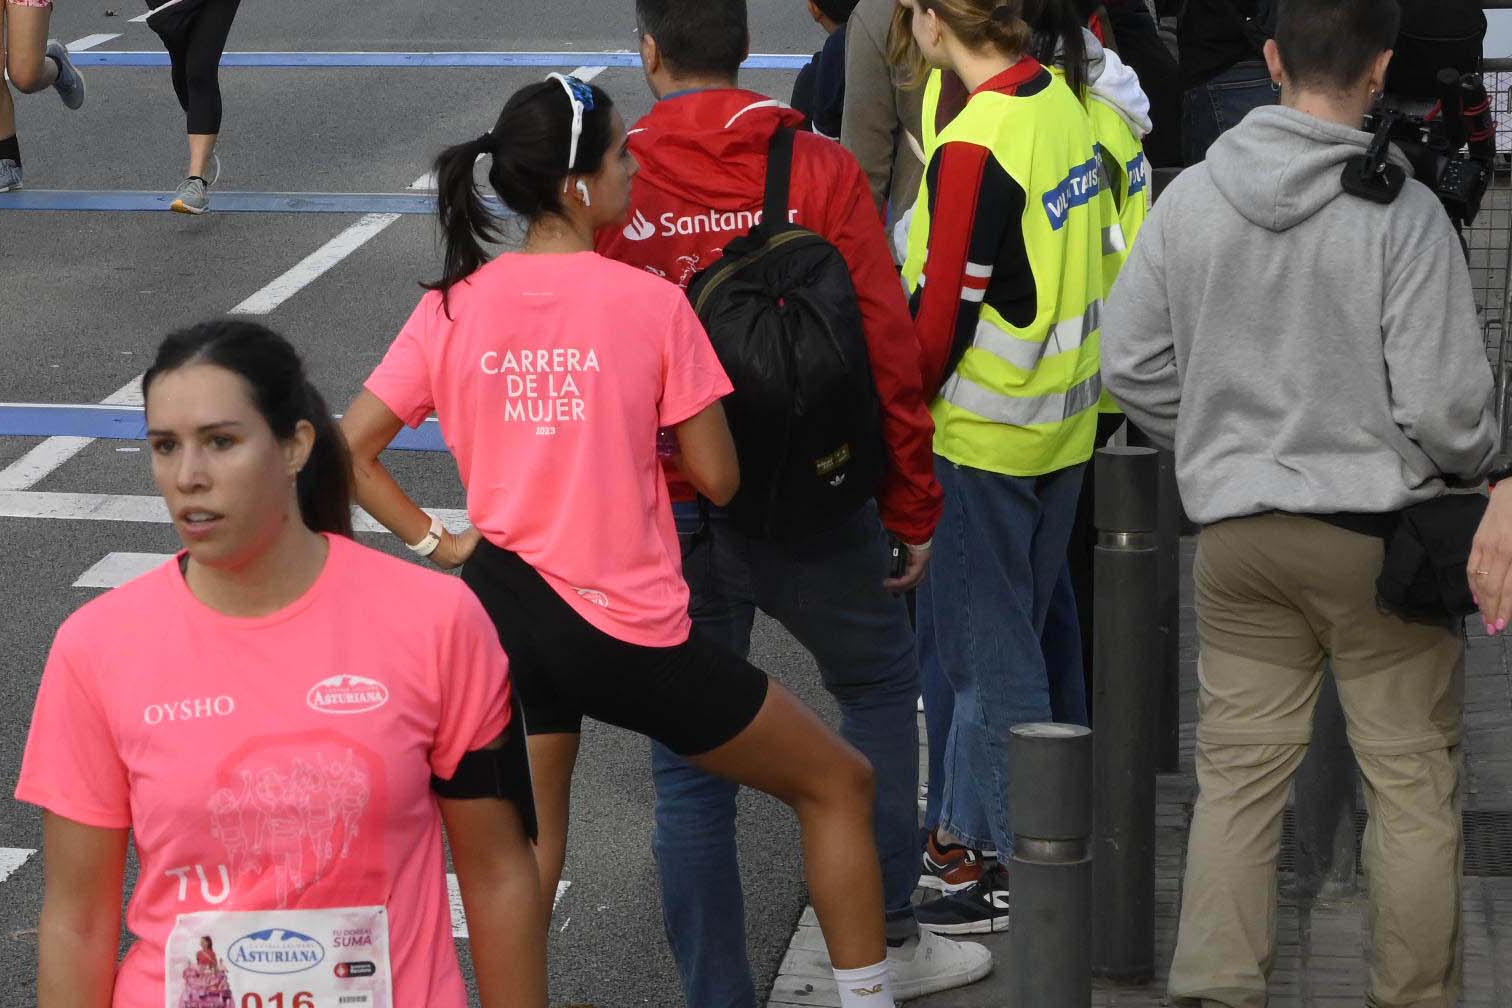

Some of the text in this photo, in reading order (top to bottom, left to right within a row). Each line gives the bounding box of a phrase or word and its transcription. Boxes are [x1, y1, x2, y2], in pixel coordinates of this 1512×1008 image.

[481, 348, 600, 374] CARRERA
[507, 373, 580, 397] DE LA
[504, 399, 585, 421] MUJER
[313, 690, 384, 706] ASTURIANA
[144, 695, 235, 725] OYSHO
[164, 864, 231, 904] TU
[333, 935, 373, 948] SUMA
[235, 946, 318, 963] ASTURIANA
[241, 991, 316, 1008] 016
